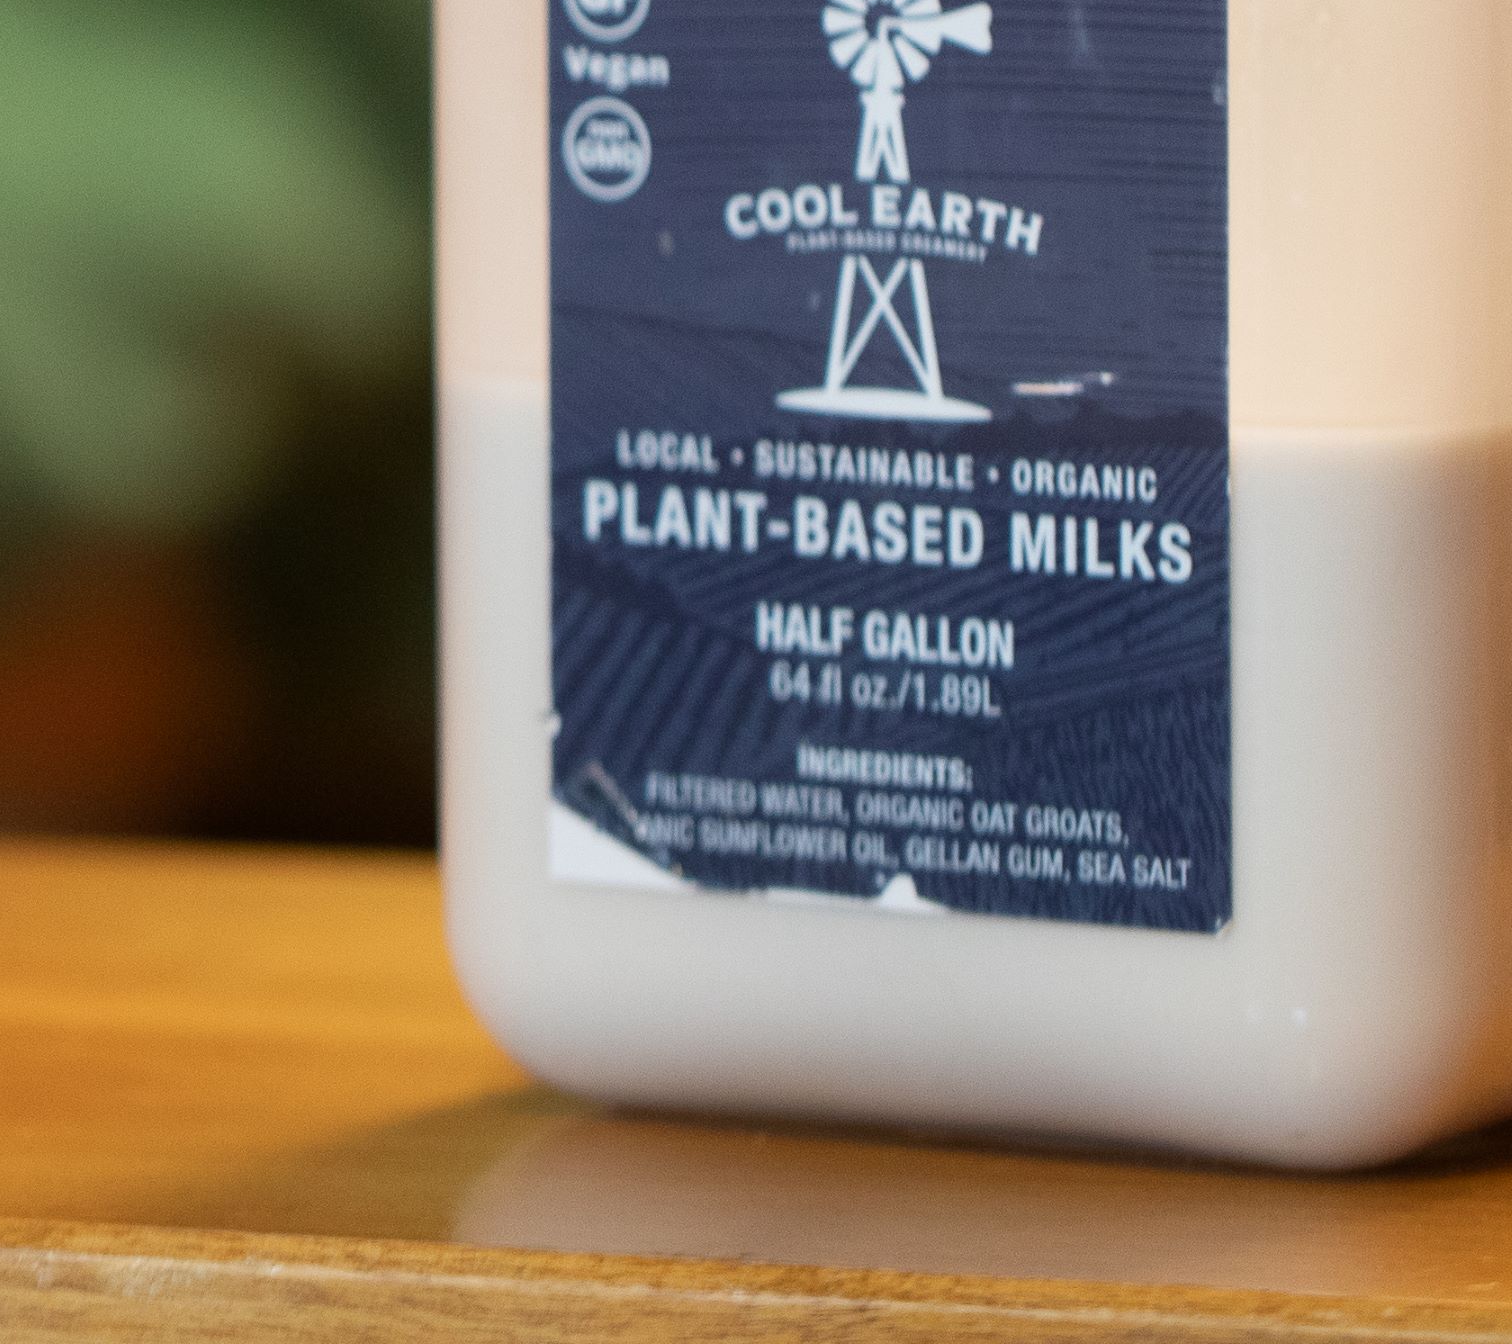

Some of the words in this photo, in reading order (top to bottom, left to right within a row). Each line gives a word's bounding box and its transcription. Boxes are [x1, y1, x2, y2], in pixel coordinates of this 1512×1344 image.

[563, 44, 670, 93] Vegan
[725, 183, 859, 240] COOL
[870, 184, 1044, 256] EARTH
[616, 428, 721, 474] LOCAL
[754, 438, 974, 492] SUSTAINABLE
[1011, 457, 1158, 504] ORGANIC
[584, 478, 984, 570] PLANT-BASED
[1010, 511, 1193, 584] MILKS
[755, 600, 855, 657] HALF
[862, 609, 1015, 672] GALLON
[796, 742, 974, 792] INGREDIENTS:
[854, 789, 964, 833] ORGANIC
[971, 799, 1019, 836] OAT
[1025, 803, 1129, 849] GROATS,
[905, 834, 1001, 877] GELLAN
[1077, 848, 1126, 885] SEA
[1132, 854, 1191, 893] SALT
